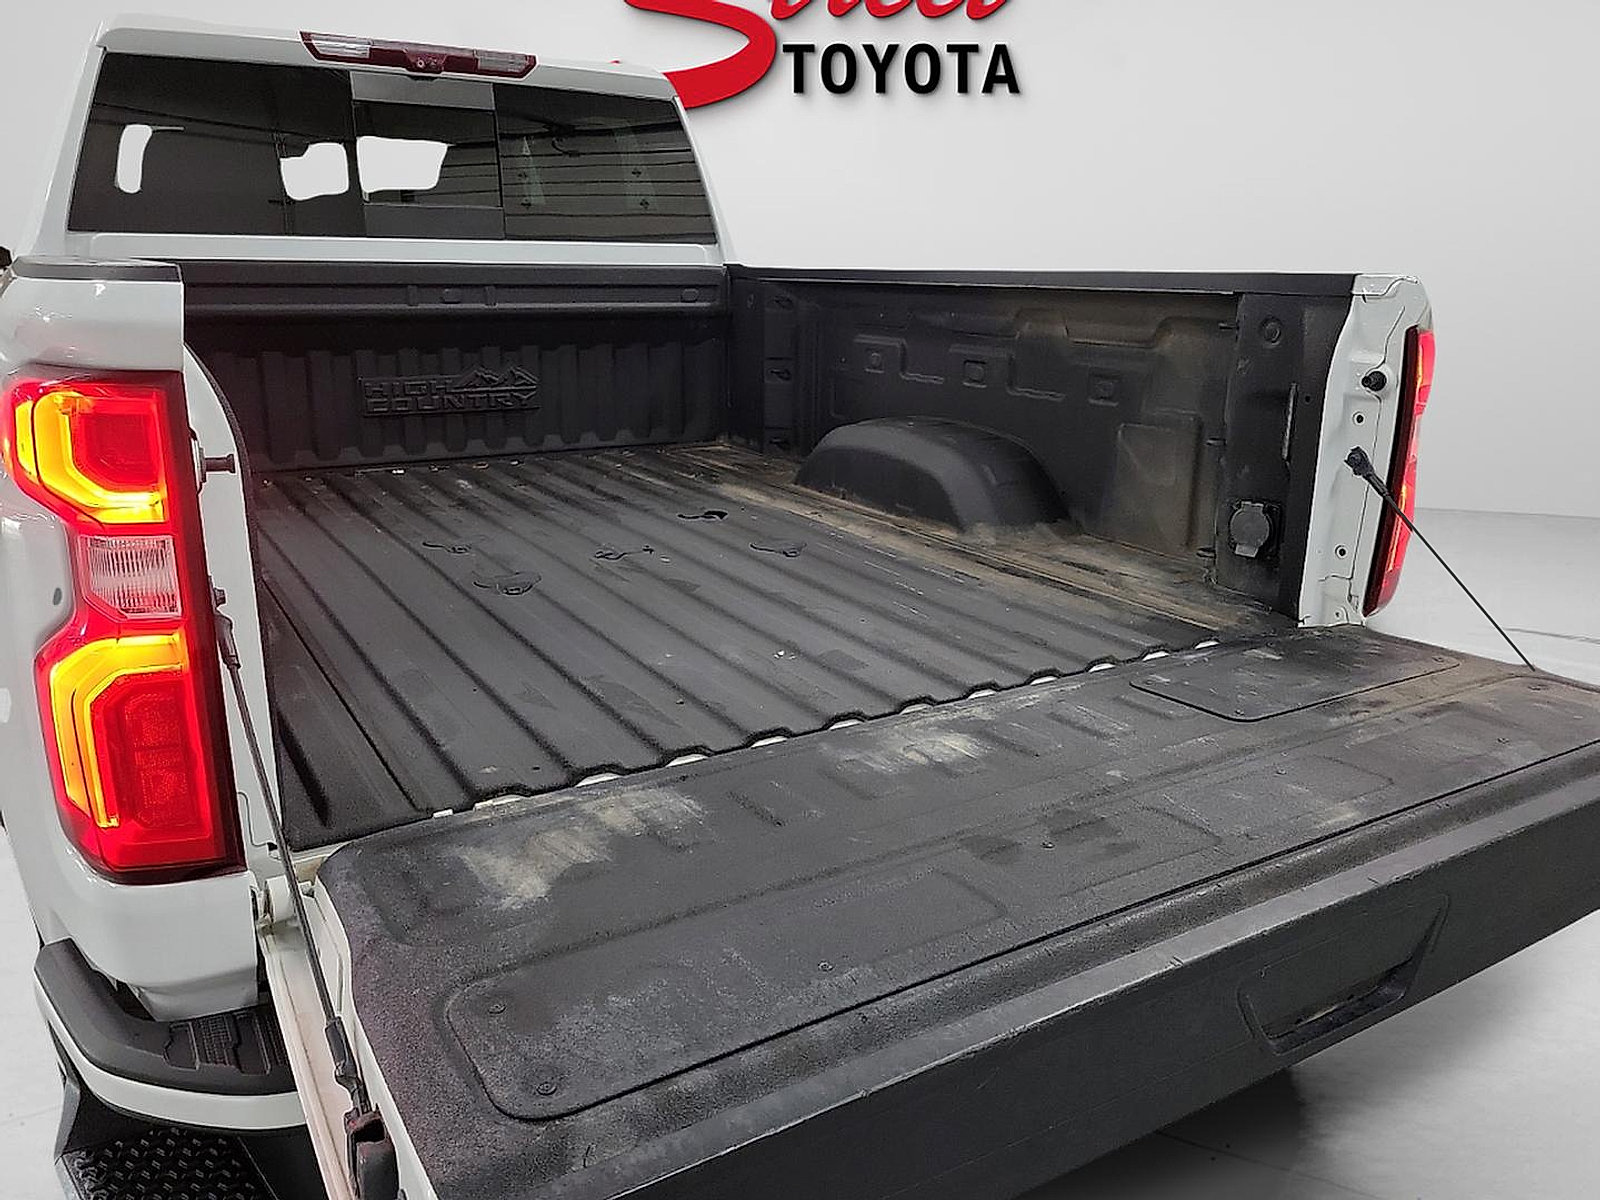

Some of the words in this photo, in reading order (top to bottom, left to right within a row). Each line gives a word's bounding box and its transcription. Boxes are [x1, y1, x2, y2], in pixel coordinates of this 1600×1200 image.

[783, 43, 1020, 95] TOYOTA
[364, 380, 453, 397] HIGH
[366, 393, 538, 412] COUNTRY
